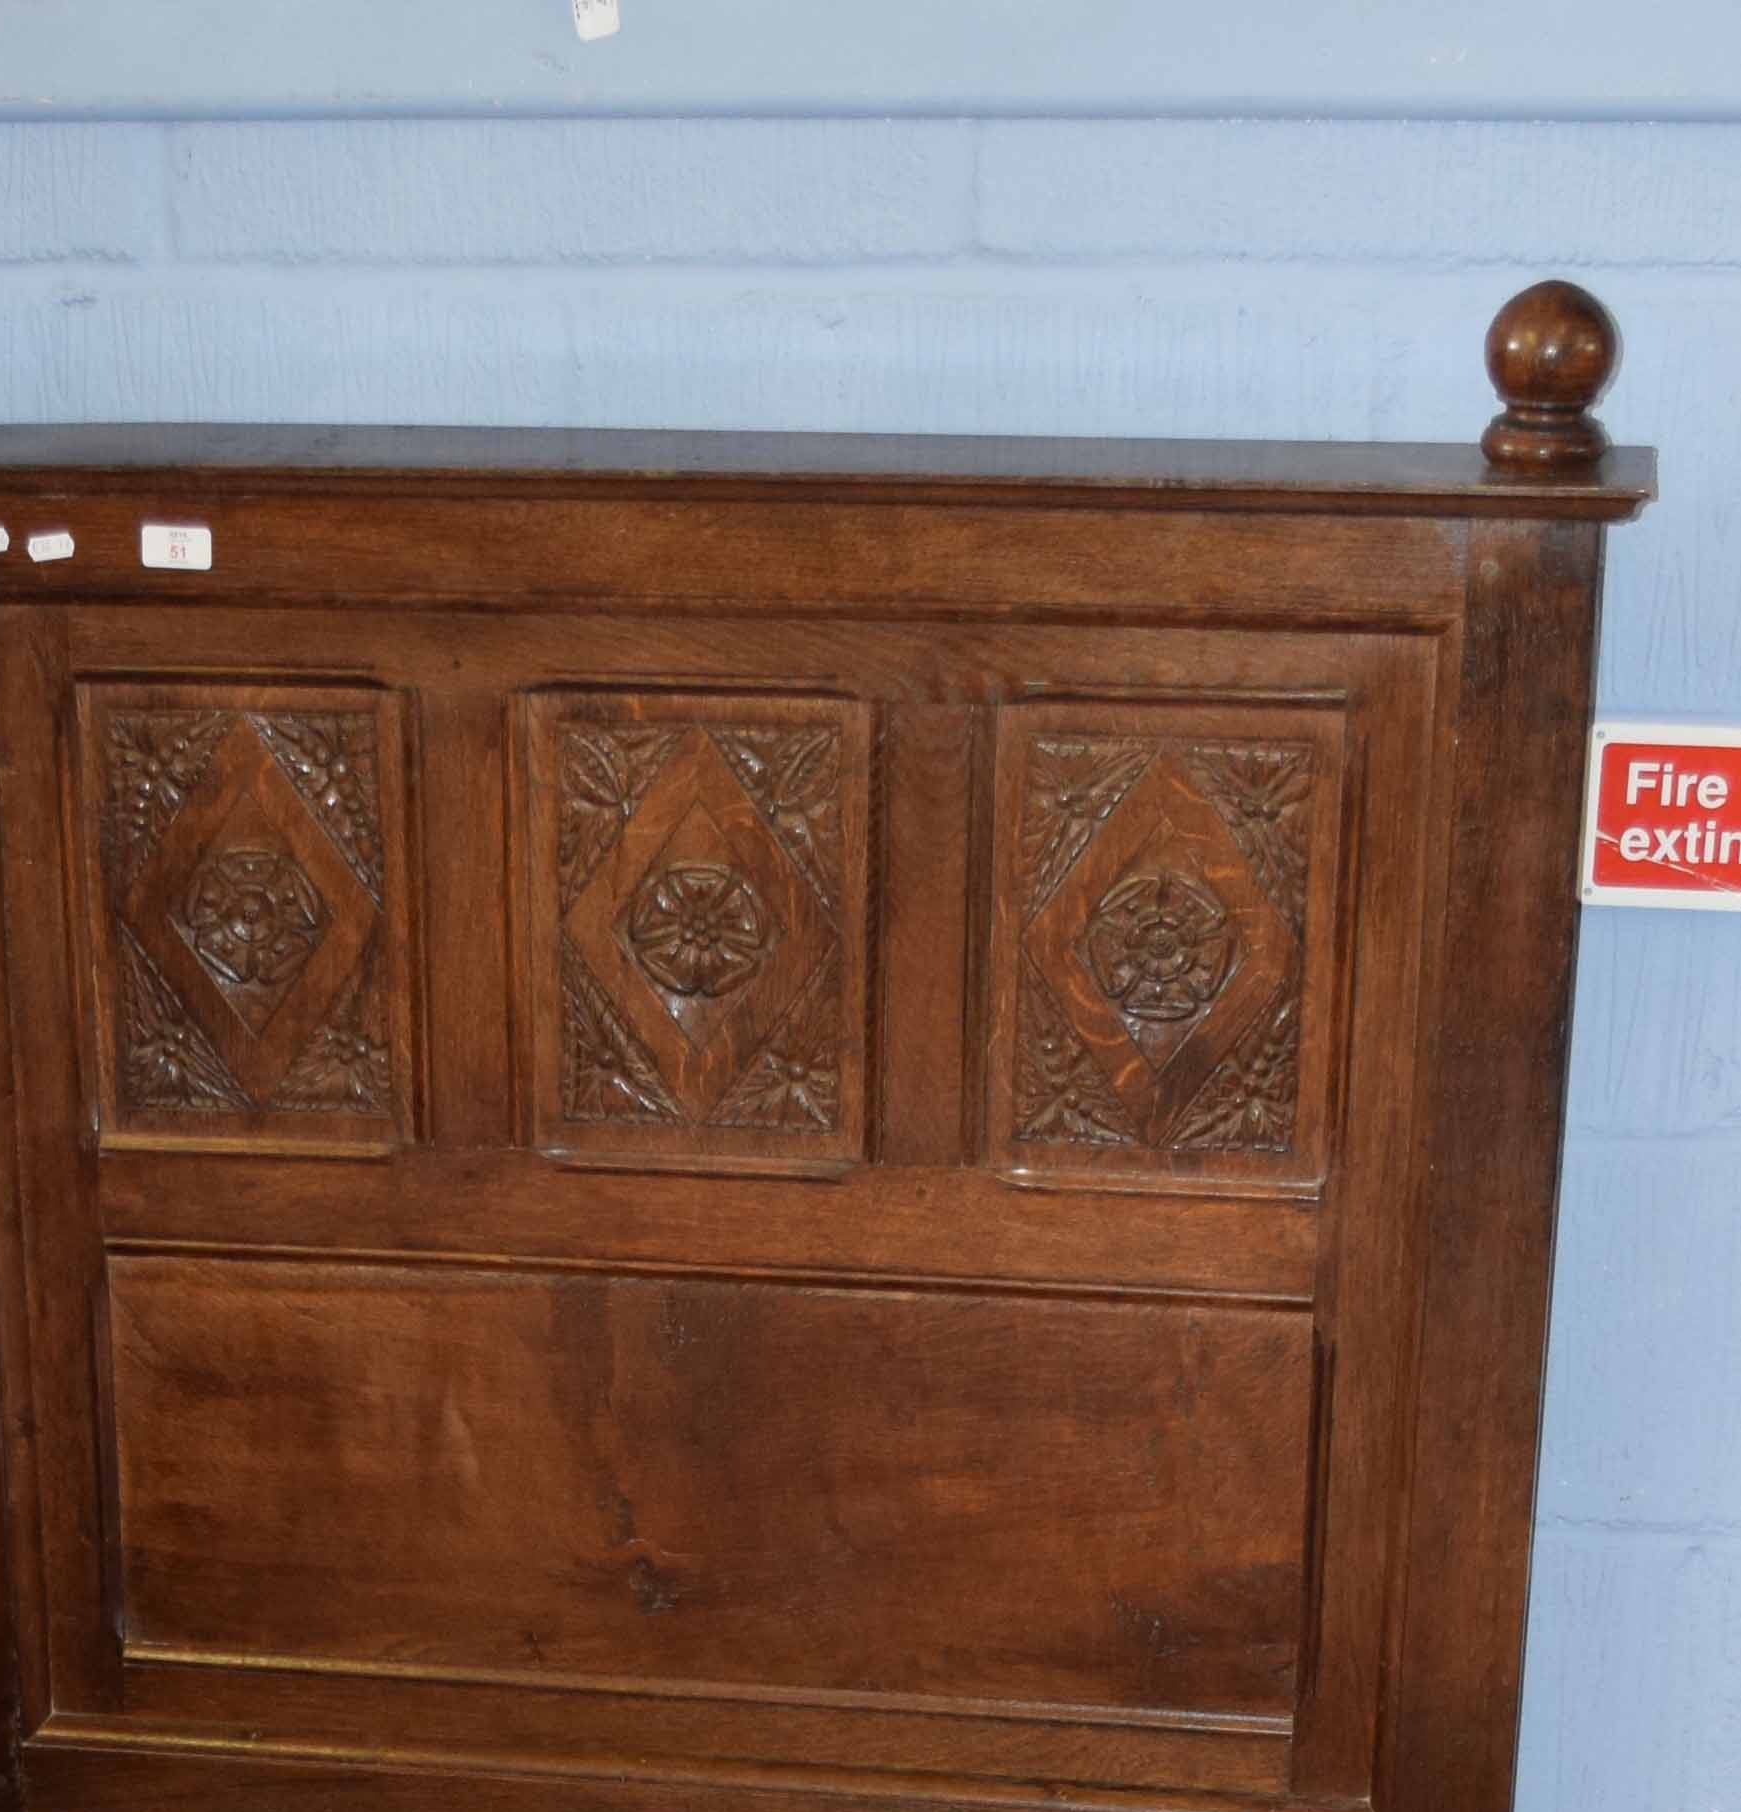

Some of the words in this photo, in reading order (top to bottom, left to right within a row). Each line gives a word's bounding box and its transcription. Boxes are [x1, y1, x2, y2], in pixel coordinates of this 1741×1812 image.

[169, 543, 188, 560] 51
[1626, 761, 1728, 809] Fire
[1620, 820, 1741, 864] extin
